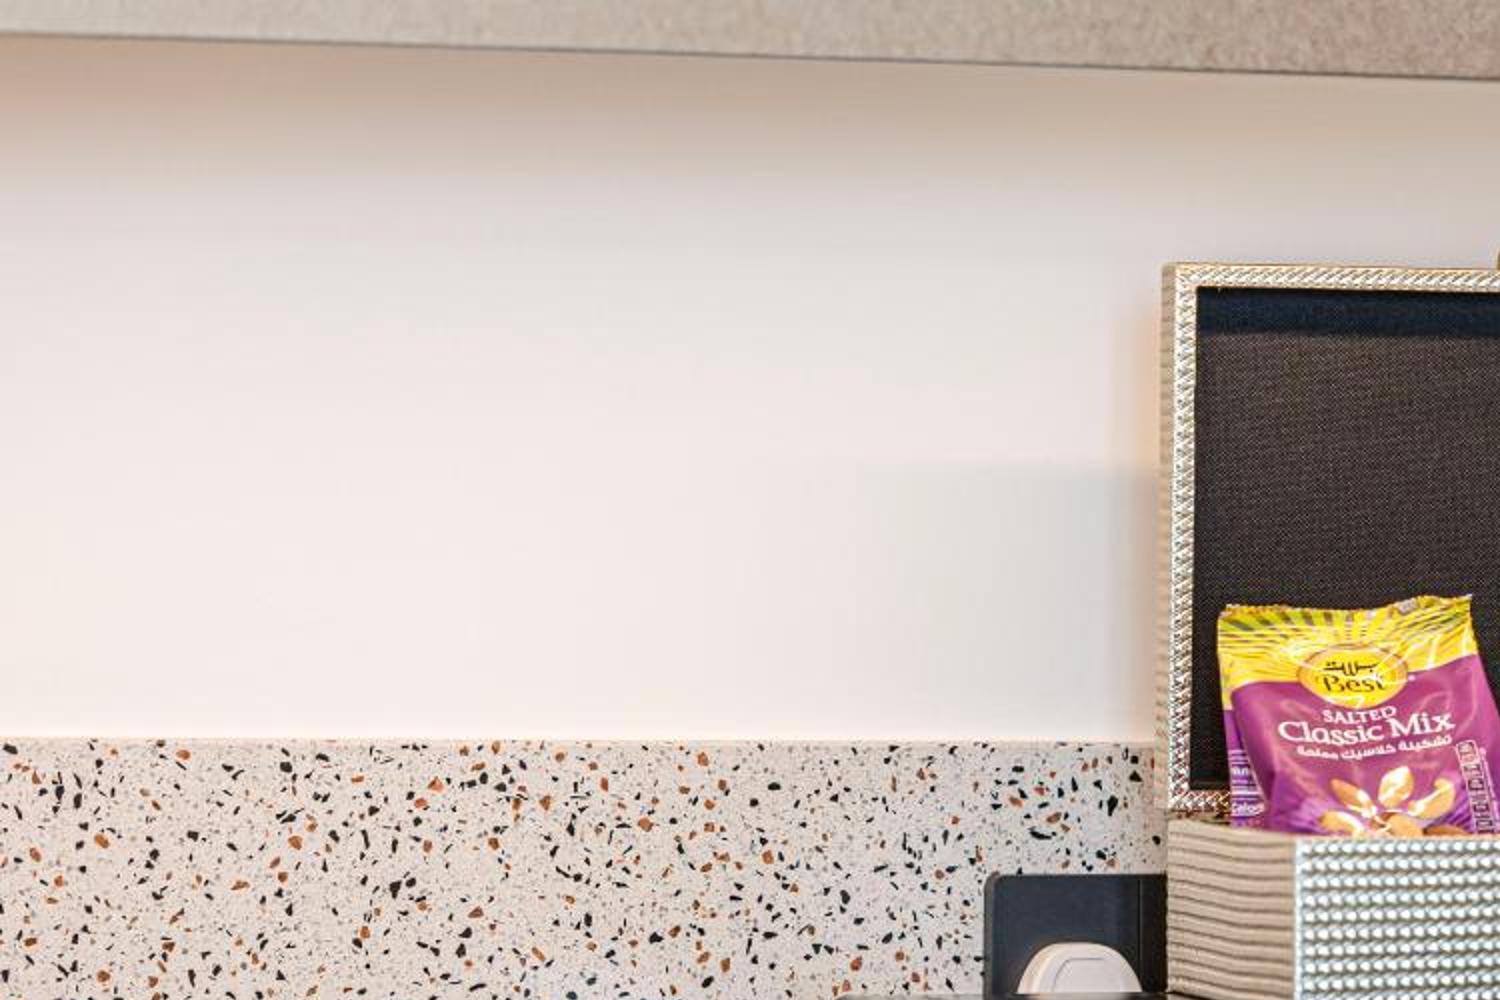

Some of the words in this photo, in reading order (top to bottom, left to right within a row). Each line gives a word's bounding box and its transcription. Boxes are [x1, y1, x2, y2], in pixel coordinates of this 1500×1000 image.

[1319, 674, 1385, 693] Best
[1321, 705, 1398, 725] SALTED
[1279, 720, 1385, 747] Classic
[1389, 711, 1456, 741] Mix
